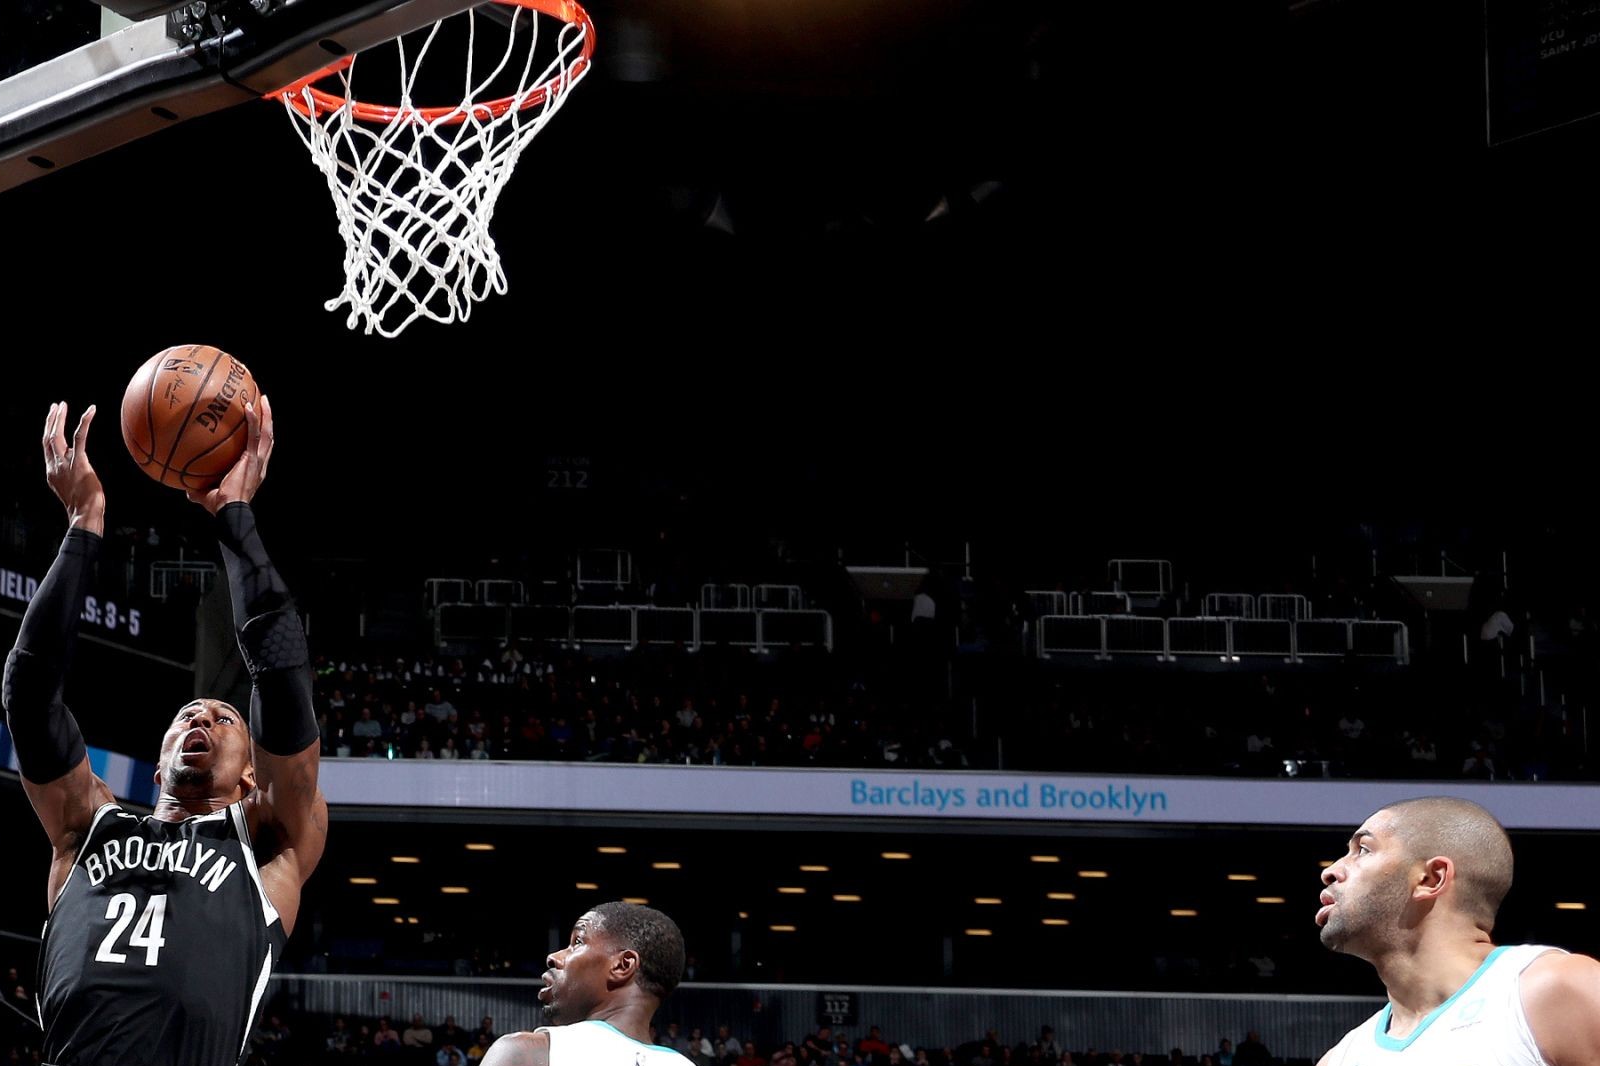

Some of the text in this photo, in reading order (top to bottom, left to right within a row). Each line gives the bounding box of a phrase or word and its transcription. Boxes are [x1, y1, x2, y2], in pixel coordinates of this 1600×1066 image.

[851, 780, 1168, 816] Barclays and Brooklyn
[85, 835, 238, 894] BROOKLYN
[94, 892, 168, 968] 24
[824, 1001, 850, 1014] 112
